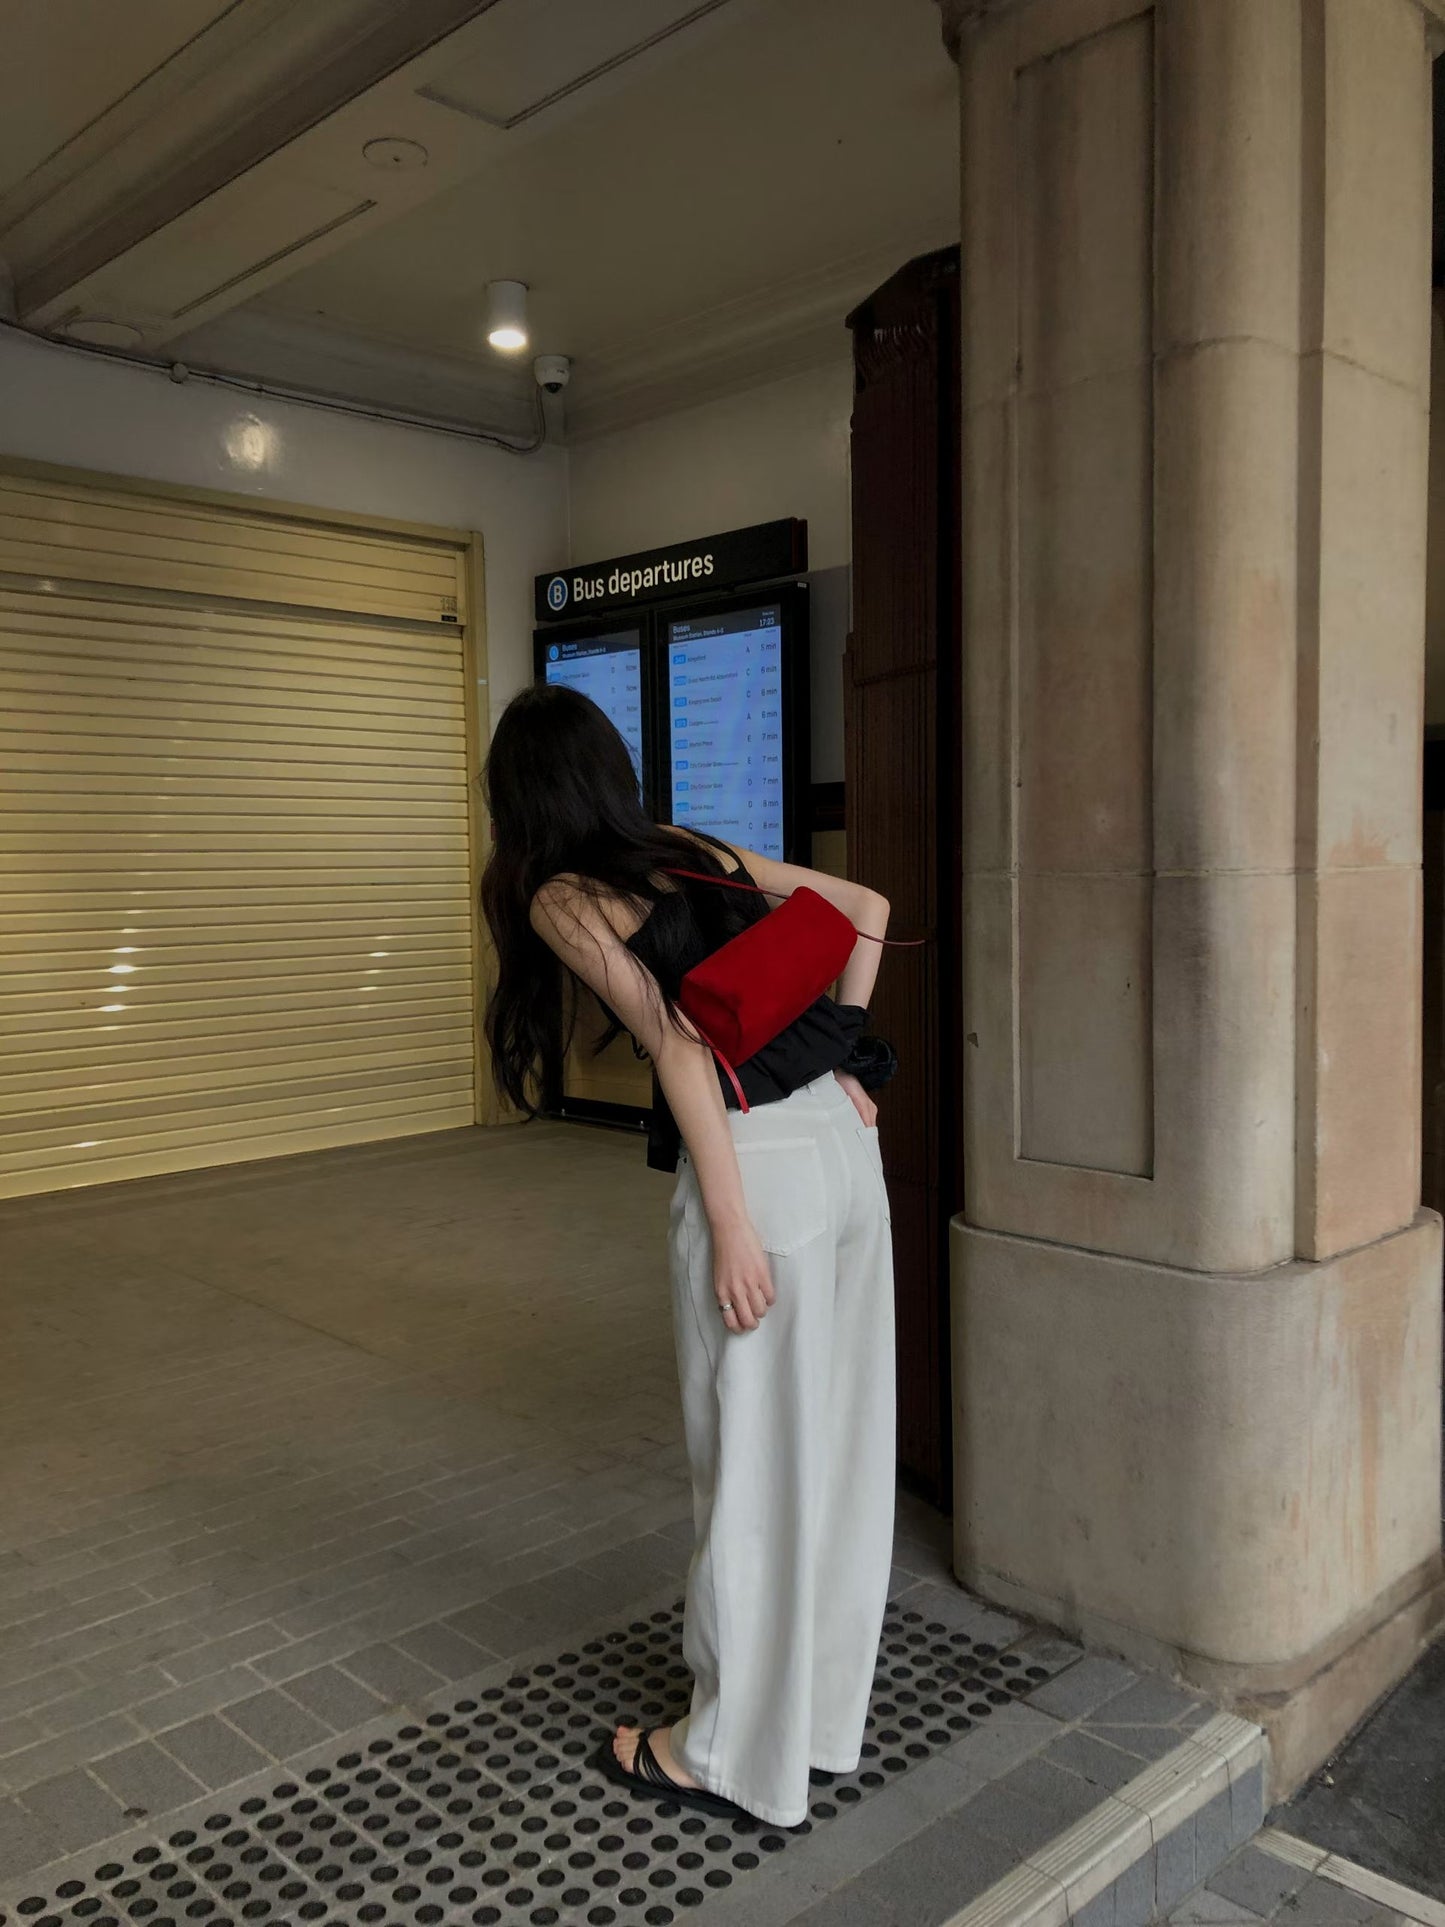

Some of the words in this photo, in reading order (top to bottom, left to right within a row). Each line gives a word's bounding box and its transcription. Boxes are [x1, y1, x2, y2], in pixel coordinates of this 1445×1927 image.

[573, 576, 605, 602] Bus
[608, 554, 714, 597] departures
[760, 617, 775, 627] 17:23
[673, 625, 691, 634] Buses
[765, 642, 777, 650] min
[766, 665, 777, 673] min
[766, 710, 778, 718] min
[767, 755, 778, 763] min
